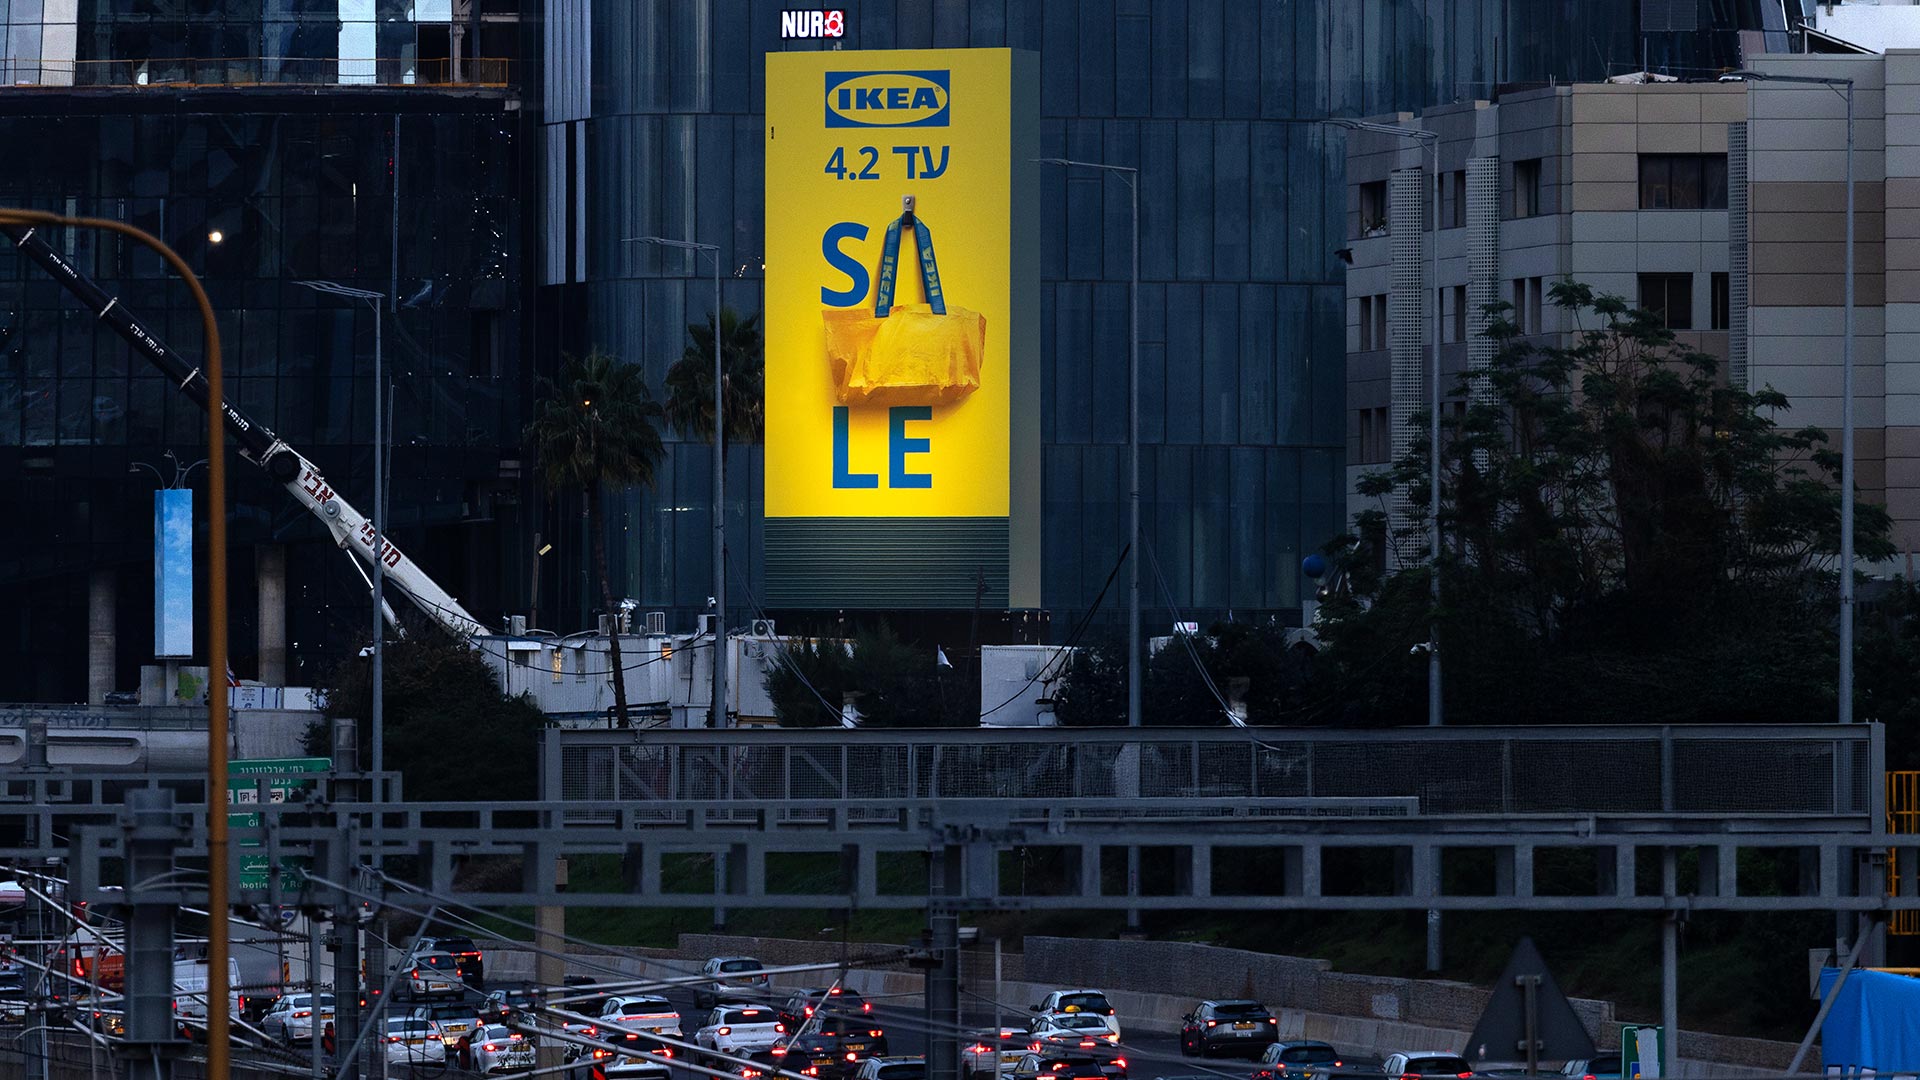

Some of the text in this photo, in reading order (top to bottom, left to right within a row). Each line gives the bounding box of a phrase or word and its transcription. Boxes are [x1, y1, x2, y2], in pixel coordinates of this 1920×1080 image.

[837, 87, 940, 110] IKEA
[825, 145, 950, 181] עד 4.2
[878, 255, 894, 307] IKEA
[922, 247, 941, 297] IKEA
[833, 406, 932, 489] LE
[303, 471, 402, 568] מנפי אבי
